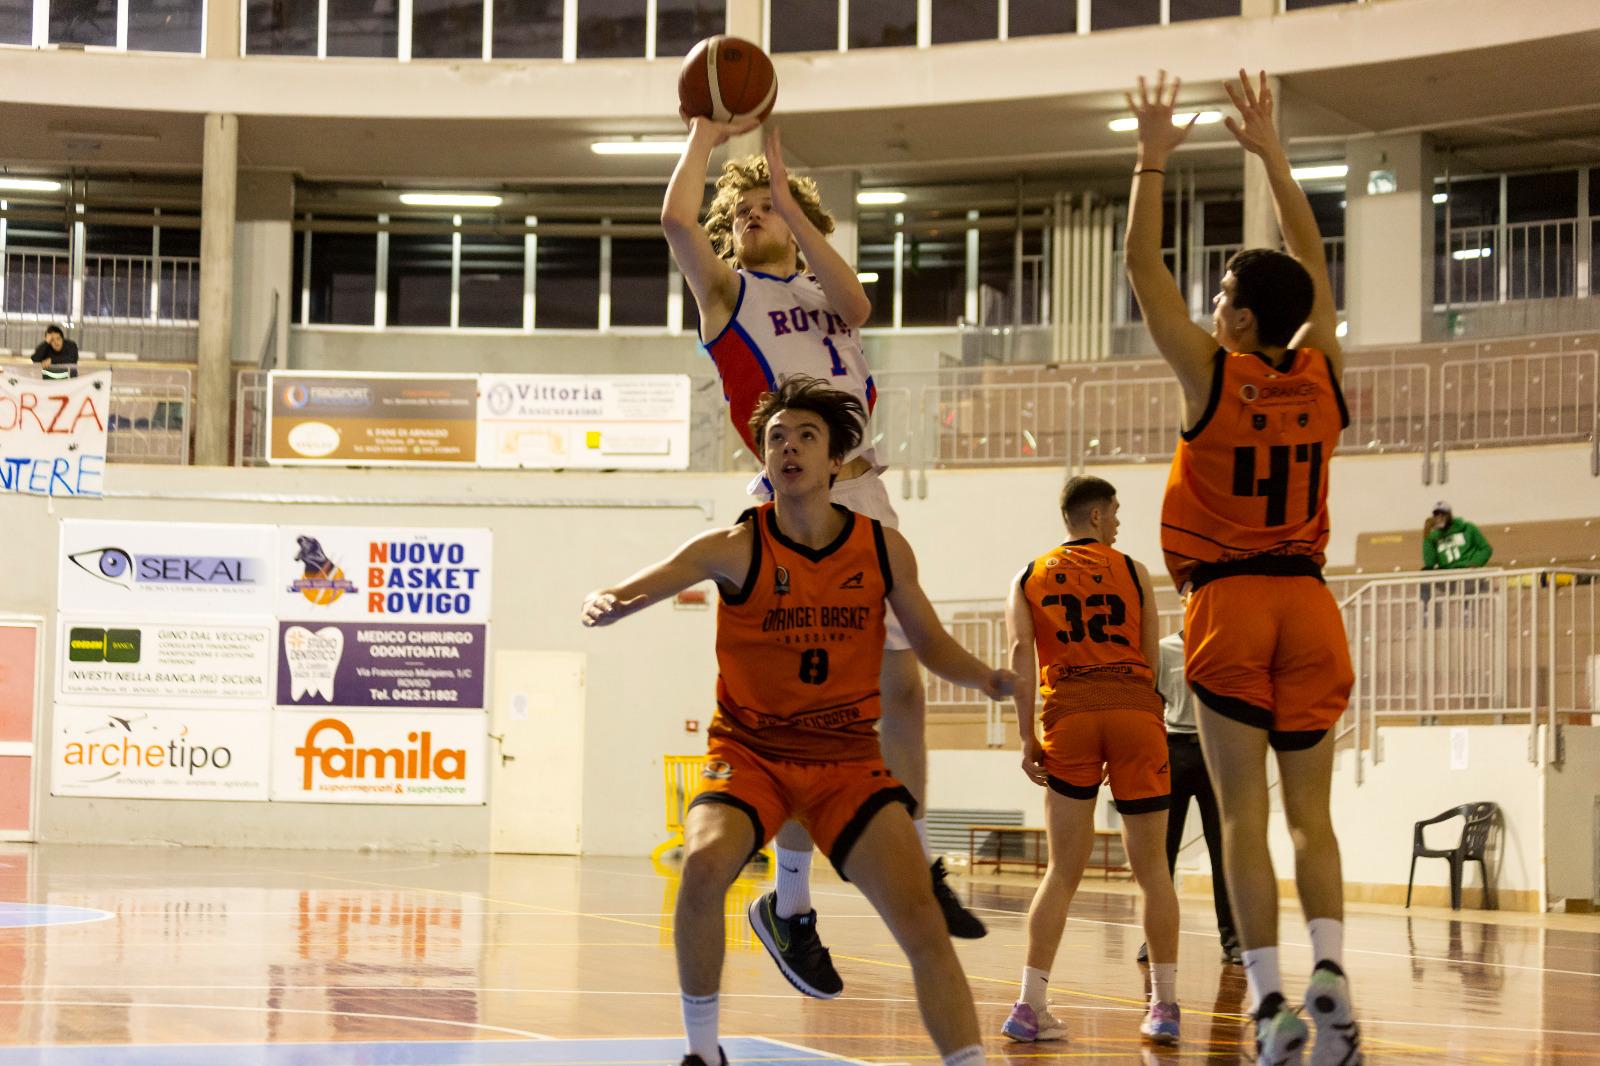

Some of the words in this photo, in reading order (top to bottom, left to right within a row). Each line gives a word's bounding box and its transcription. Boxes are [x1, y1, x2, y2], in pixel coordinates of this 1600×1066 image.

[822, 336, 848, 377] 1
[516, 383, 603, 401] Vittoria
[1233, 441, 1323, 527] 41
[369, 542, 465, 565] NUOVO
[141, 558, 256, 583] SEKAL
[368, 567, 480, 589] BASKET
[368, 592, 471, 614] ROVIGO
[1041, 594, 1130, 645] 32
[158, 631, 188, 640] GINO
[190, 631, 210, 640] DAL
[215, 632, 264, 641] VECCHIO
[356, 630, 406, 643] MEDICO
[408, 631, 474, 644] CHIRURGO
[369, 645, 460, 658] ODONTOIATRA
[68, 671, 112, 680] INVESTI
[114, 672, 151, 681] NELLA
[155, 672, 196, 682] BANCA
[221, 673, 263, 684] SICURA
[356, 667, 370, 677] Via
[799, 648, 829, 686] 8
[369, 688, 391, 701] Tel.
[64, 736, 232, 776] archetipo
[295, 718, 466, 791] famila
